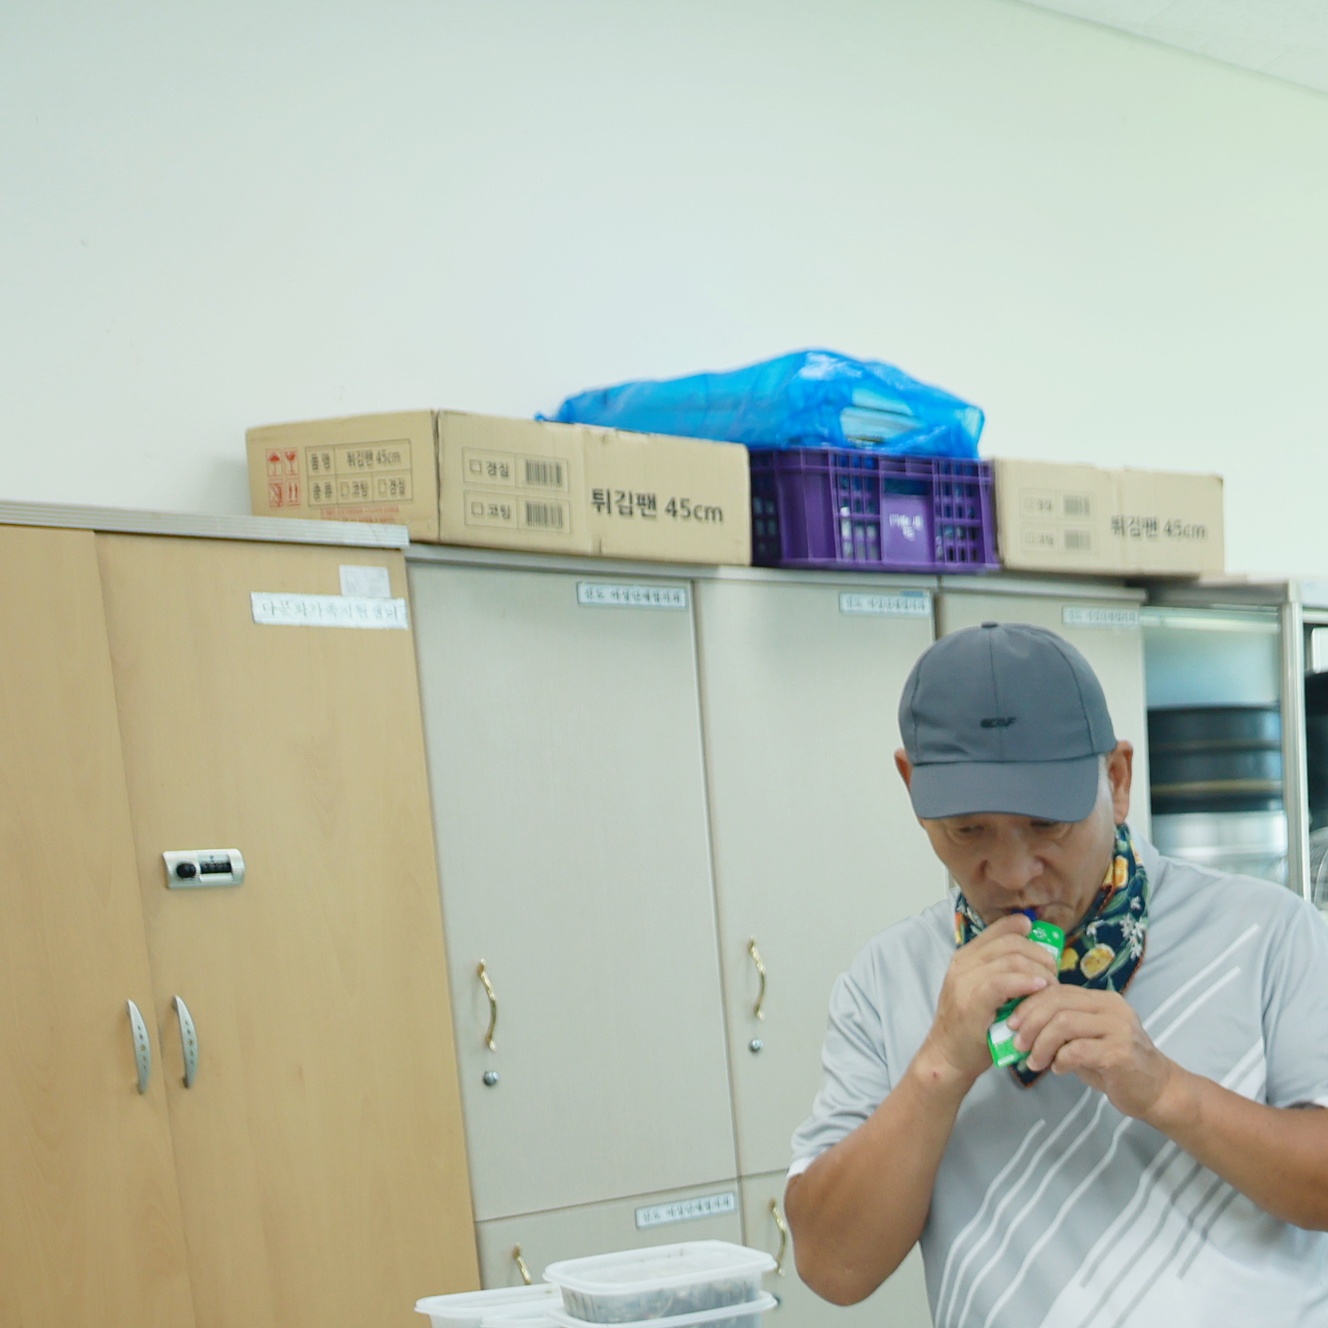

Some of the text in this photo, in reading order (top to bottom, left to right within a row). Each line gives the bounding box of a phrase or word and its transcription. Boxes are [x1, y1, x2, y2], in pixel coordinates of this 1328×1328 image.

[375, 449, 401, 467] 45cm
[591, 487, 724, 524] 튀김팬 45cm
[1110, 514, 1207, 540] 튀김팬 45cm
